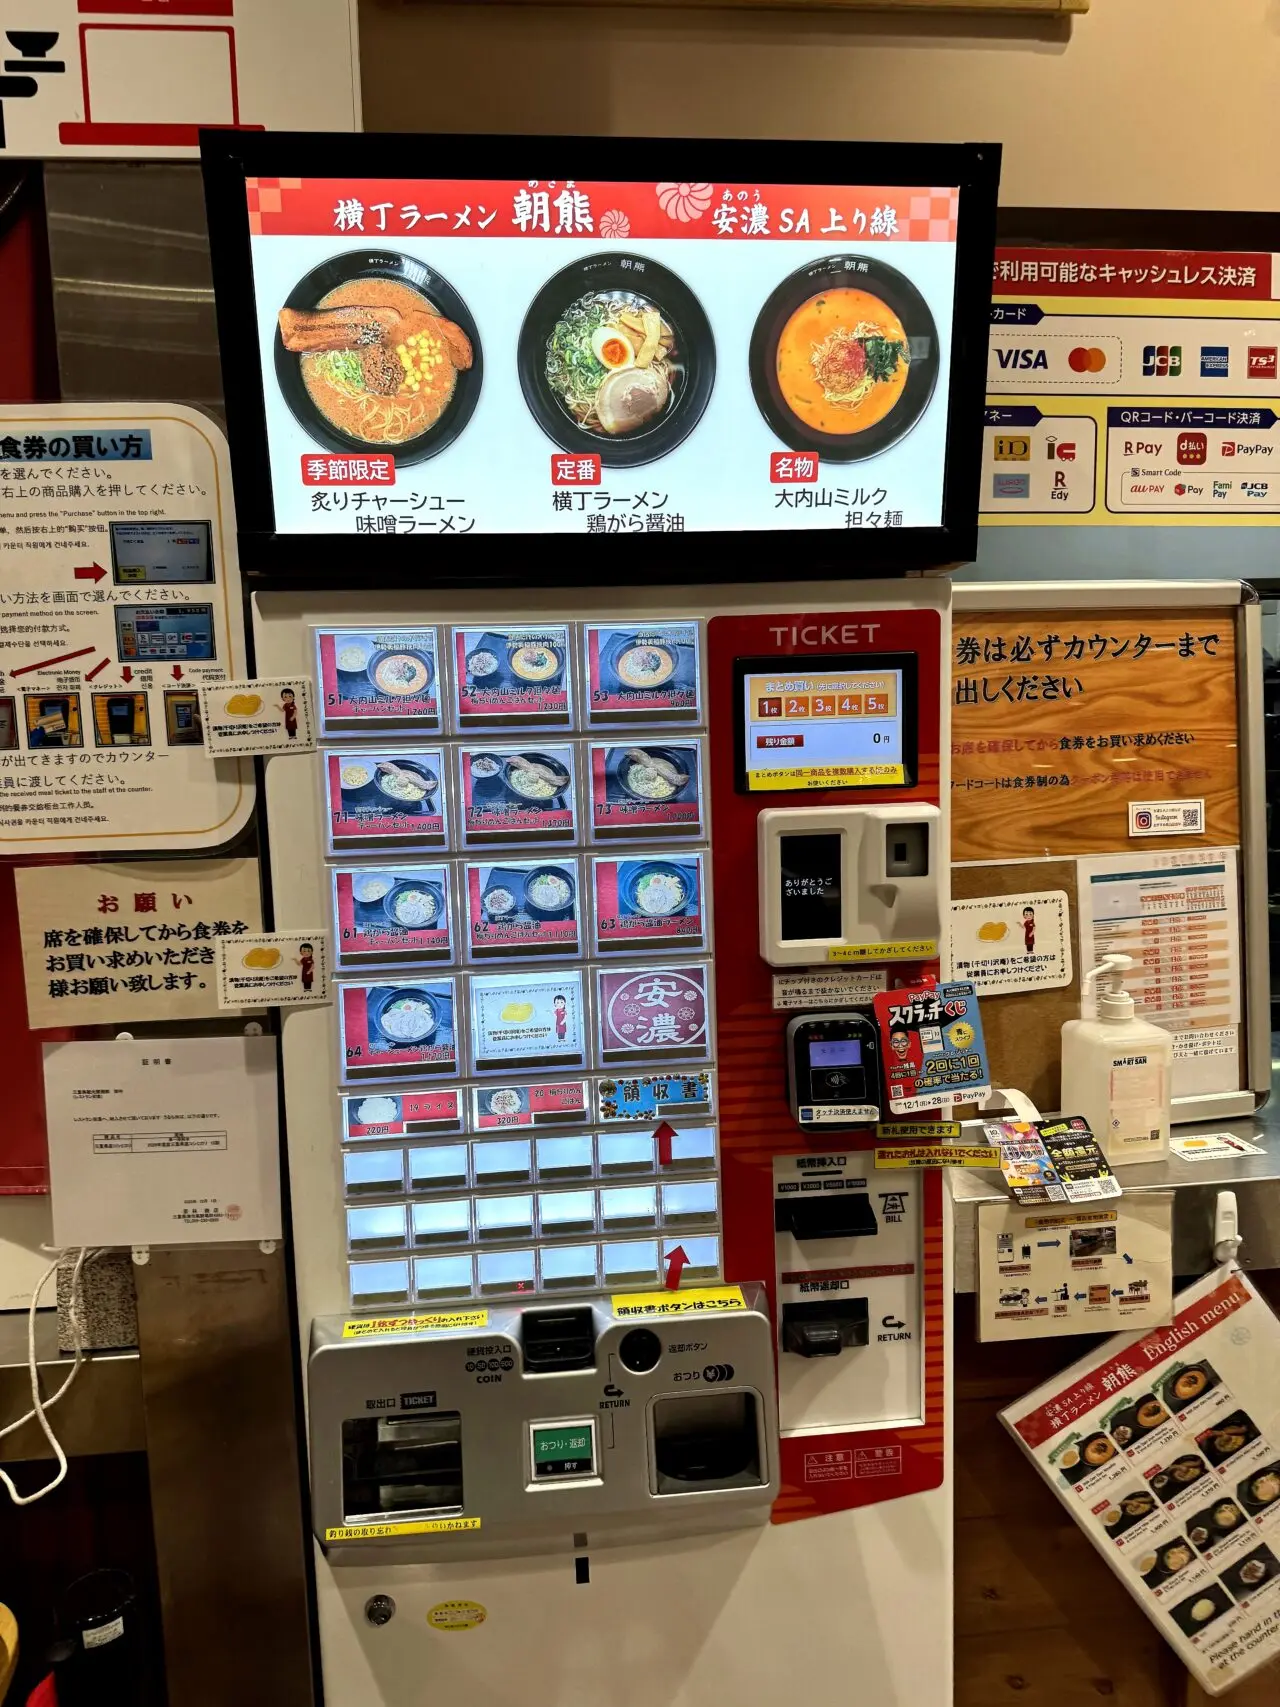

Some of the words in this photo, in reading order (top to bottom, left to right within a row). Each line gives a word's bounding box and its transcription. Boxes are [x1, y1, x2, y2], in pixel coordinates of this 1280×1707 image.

[333, 198, 498, 232] 横丁ラーメン
[512, 189, 594, 234] 朝熊
[712, 203, 771, 236] 安濃
[779, 208, 810, 234] SA
[820, 205, 899, 236] 上り線
[992, 349, 1048, 369] VISA
[1121, 411, 1260, 425] QRコード・バーコード決済
[0, 435, 144, 460] 食券の買い方
[1136, 443, 1162, 456] Pay
[1237, 444, 1273, 456] PayPay
[1, 467, 112, 480] を選んでください。
[307, 460, 390, 480] 季節限定
[556, 460, 595, 480] 定番
[775, 457, 813, 478] 名物
[1141, 468, 1164, 476] Smart
[1165, 468, 1181, 476] Code
[1149, 485, 1164, 493] PAY
[1187, 486, 1203, 495] Pay
[1213, 481, 1232, 490] Fami
[552, 490, 669, 511] 横丁ラーメン
[775, 488, 888, 508] 大内山ミルク
[1051, 491, 1068, 500] Edy
[1213, 490, 1227, 499] Pay
[311, 492, 465, 511] 炙りチャーシュー
[356, 515, 475, 533] 味噌ラーメン
[587, 513, 684, 533] 鶏がら醤油
[845, 510, 903, 529] 担々麺
[769, 624, 880, 646] TICKET
[956, 632, 1220, 664] 券は必ずカウンターまで
[462, 686, 476, 697] 52
[594, 691, 609, 701] 53
[956, 675, 1084, 704] 出しください
[328, 694, 342, 705] 51
[1, 751, 169, 767] が出てきますのでカウンター
[468, 806, 483, 817] 72
[597, 805, 612, 815] 73
[785, 878, 832, 887] ありがとうご
[785, 888, 824, 896] ざいました
[474, 922, 488, 932] 62
[601, 919, 615, 930] 63
[343, 928, 357, 938] 61
[49, 972, 206, 998] 様お願い致します。
[908, 990, 940, 1002] PayPay
[633, 978, 684, 1044] 安濃
[347, 1046, 362, 1058] 64
[623, 1082, 698, 1102] 領収書
[963, 1092, 985, 1101] PayPay
[886, 1215, 902, 1223] BILL
[1142, 1320, 1199, 1361] English
[1201, 1292, 1241, 1326] menu
[877, 1332, 911, 1342] RETURN
[477, 1374, 501, 1383] COIN
[673, 1371, 700, 1381] おつり
[1101, 1363, 1139, 1393] 朝熊
[404, 1396, 434, 1406] TICKET
[600, 1400, 630, 1410] RETURN
[541, 1438, 585, 1451] おつり・返却
[1210, 1642, 1238, 1663] Please
[1239, 1623, 1261, 1643] hand
[1264, 1617, 1272, 1625] in
